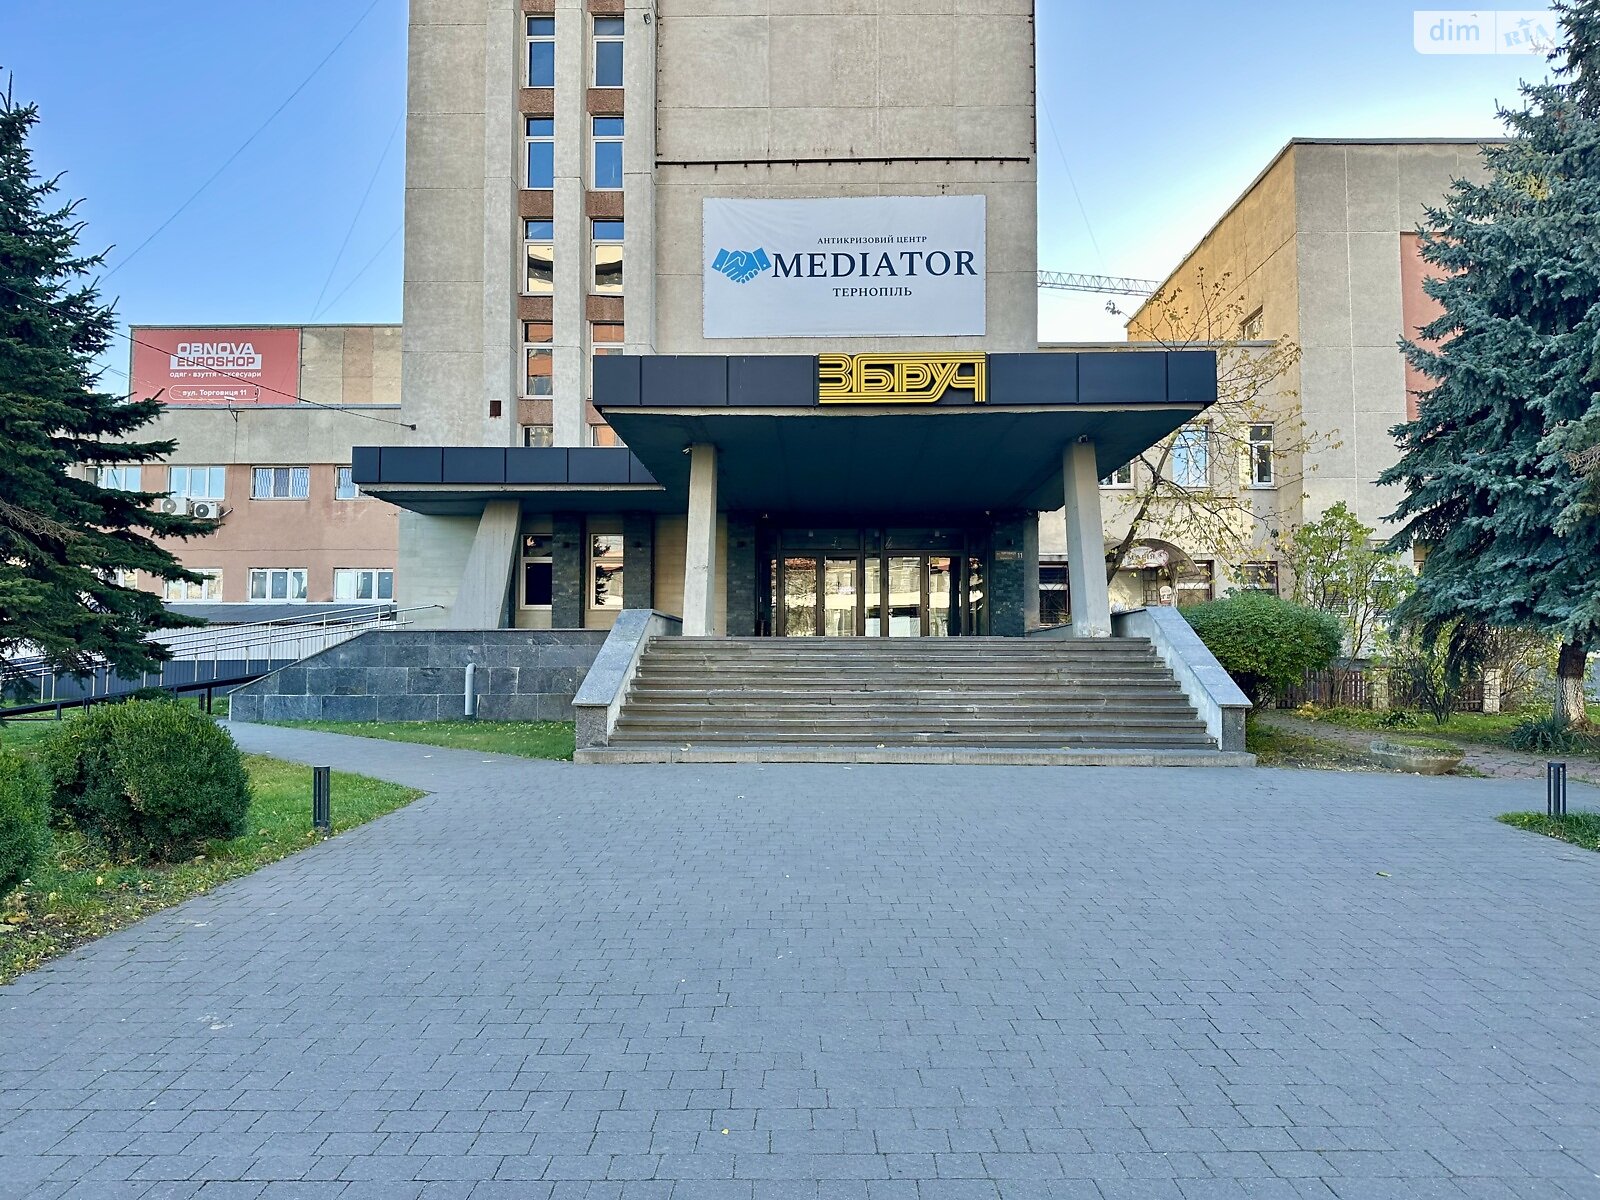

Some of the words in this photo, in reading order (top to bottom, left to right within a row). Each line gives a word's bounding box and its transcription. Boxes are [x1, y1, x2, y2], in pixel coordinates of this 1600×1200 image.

[817, 235, 893, 245] АНТИКРИЗОВИЙ
[896, 235, 927, 245] ЦЕНТР
[772, 250, 978, 278] MEDIATOR
[832, 287, 912, 297] ТЕРНОПІЛЬ
[177, 343, 255, 355] OBNOVA
[177, 356, 256, 367] EUROSHOP
[819, 352, 986, 404] ЗБРУЧ
